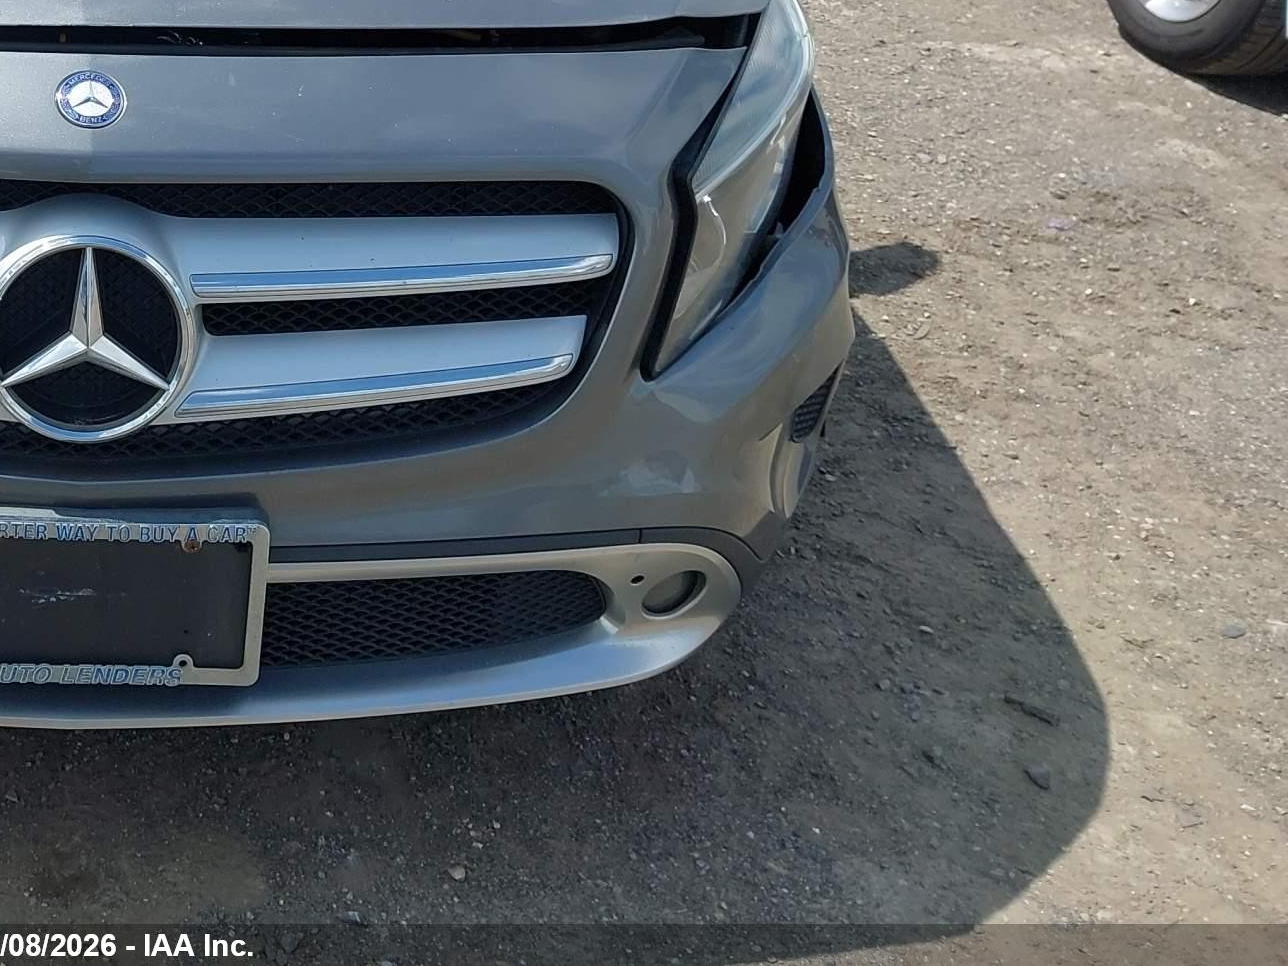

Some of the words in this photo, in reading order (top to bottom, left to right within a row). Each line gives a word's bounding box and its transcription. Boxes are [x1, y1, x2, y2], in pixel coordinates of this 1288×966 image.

[56, 522, 99, 542] WAY
[106, 525, 131, 543] TO
[138, 525, 181, 544] BUY
[183, 526, 201, 544] A
[59, 665, 183, 687] LENDERS
